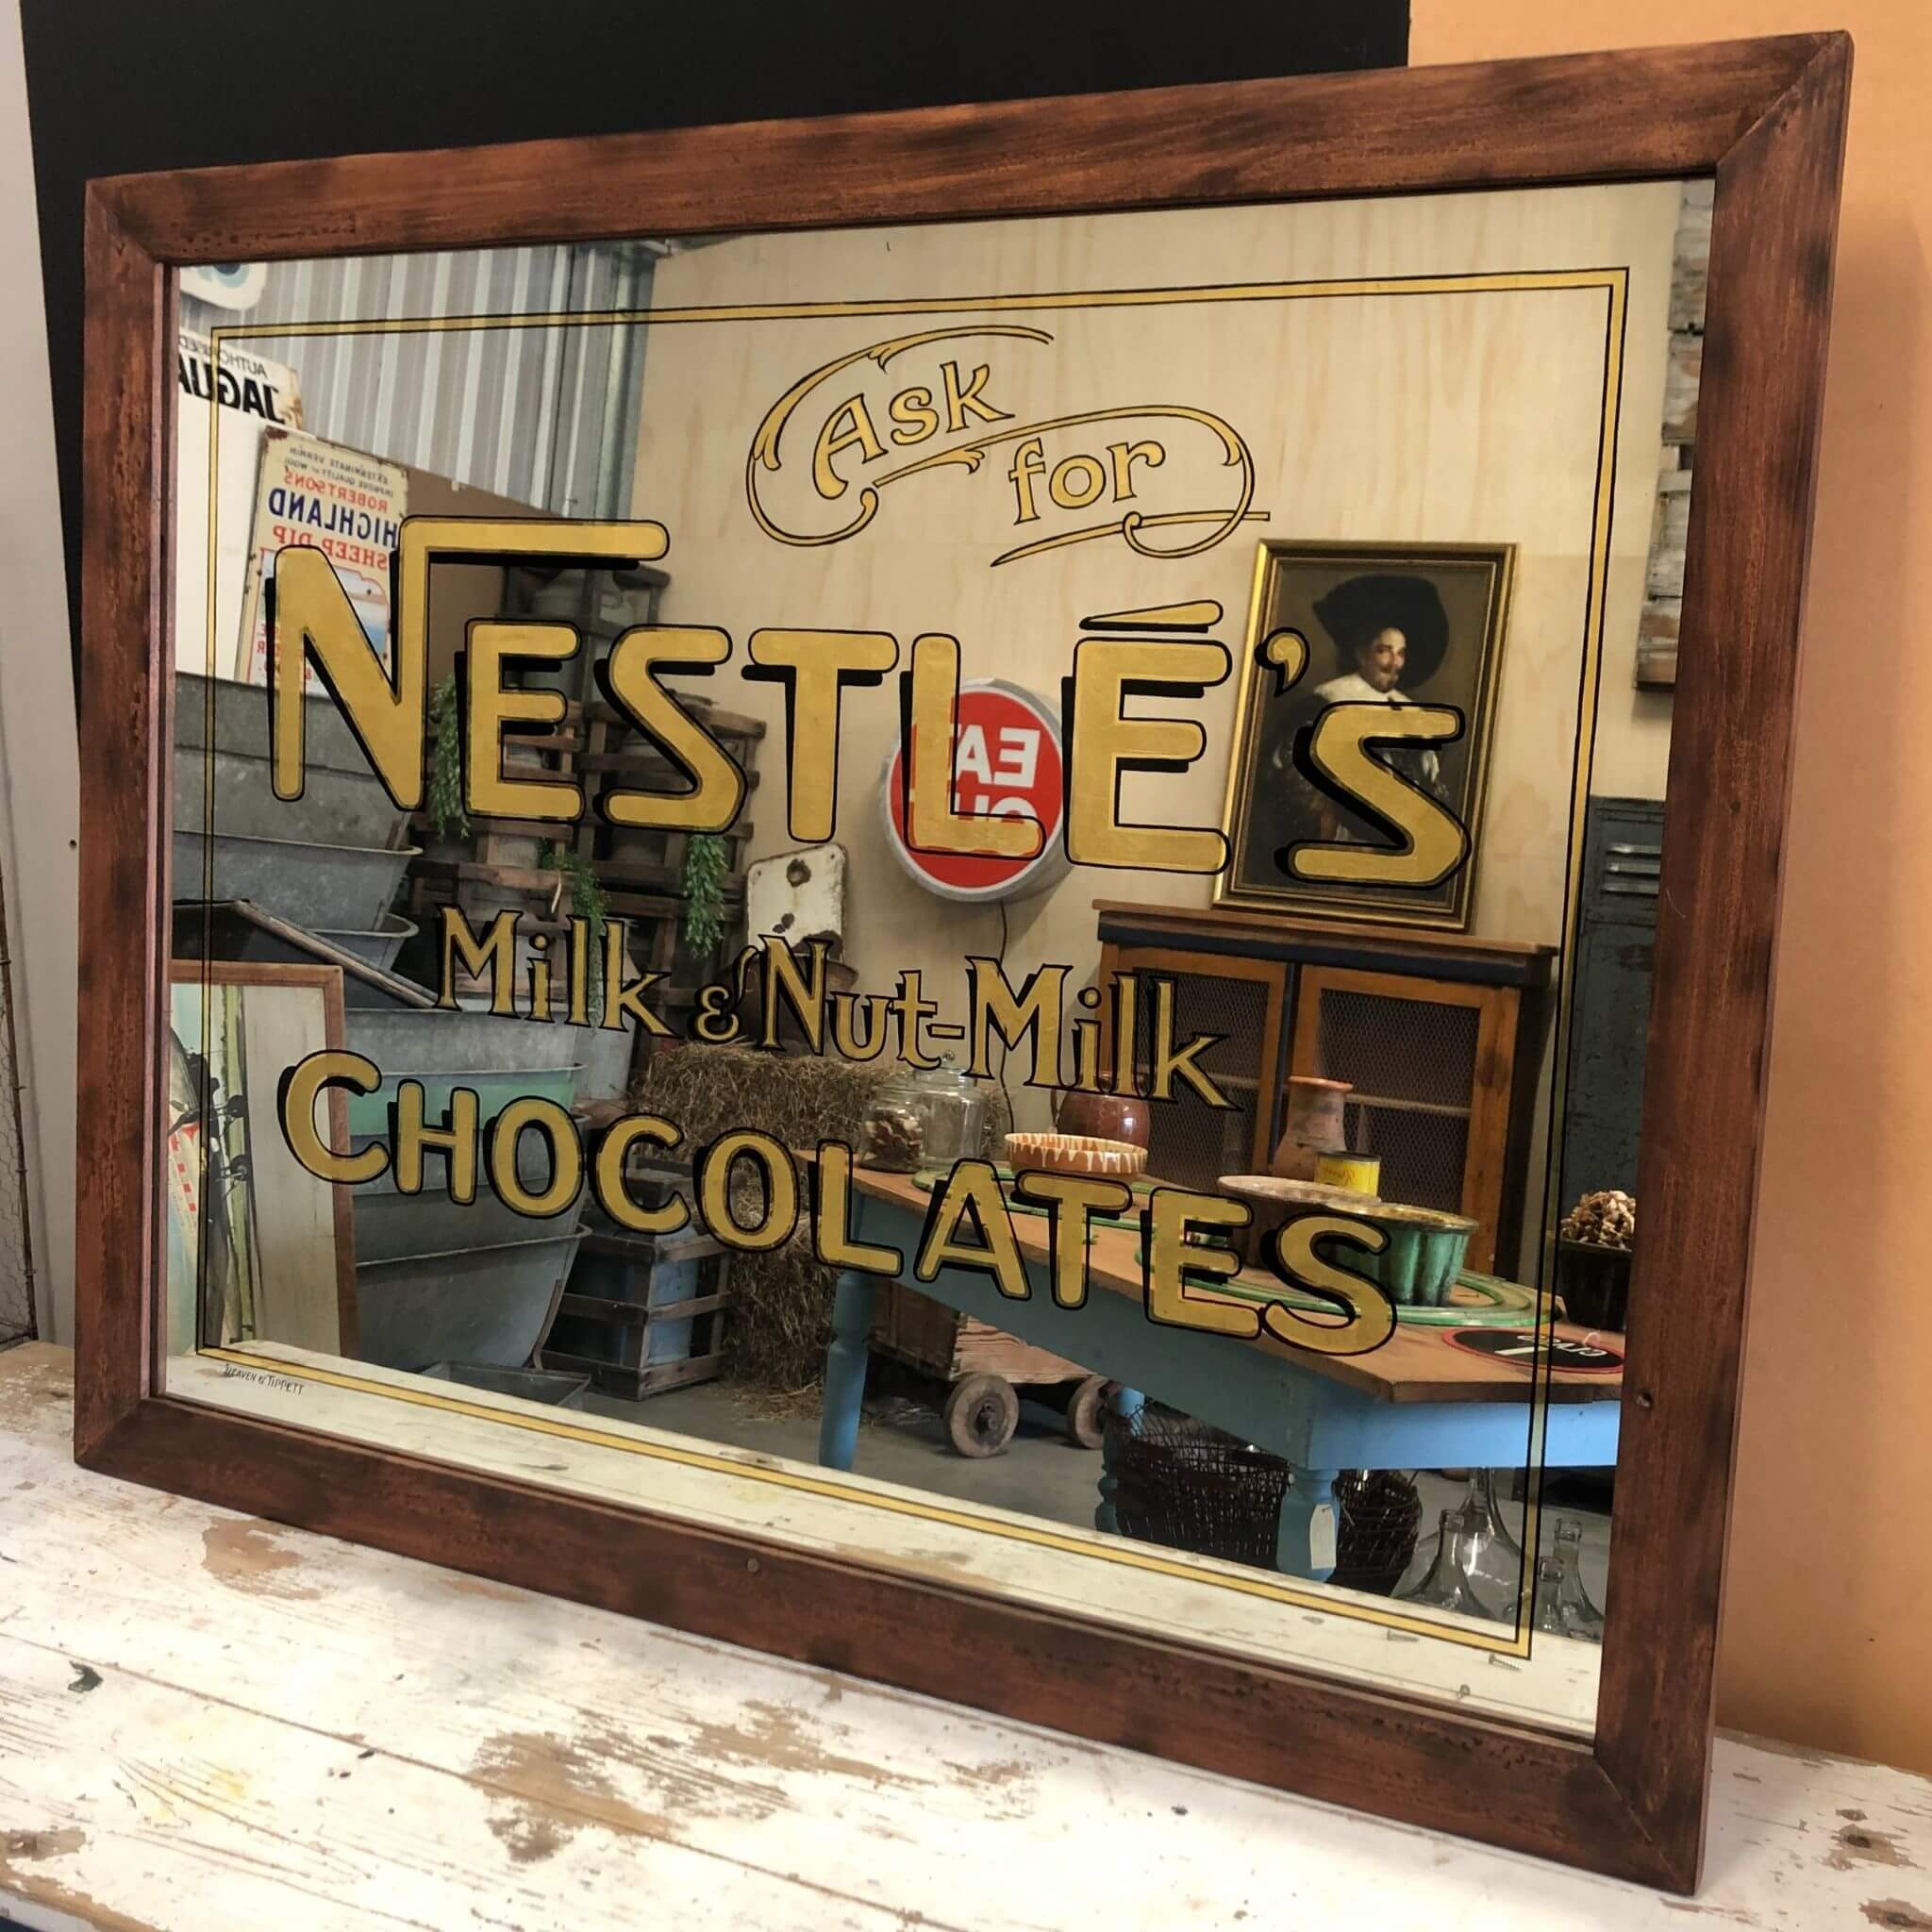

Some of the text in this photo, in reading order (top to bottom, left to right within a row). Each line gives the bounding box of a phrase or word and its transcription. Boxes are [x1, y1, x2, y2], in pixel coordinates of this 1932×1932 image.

[812, 359, 1016, 500] Ask
[1008, 437, 1166, 525] for
[432, 903, 1243, 1111] Milk & Nut-Milk
[277, 1048, 1399, 1356] CHOCOLATES
